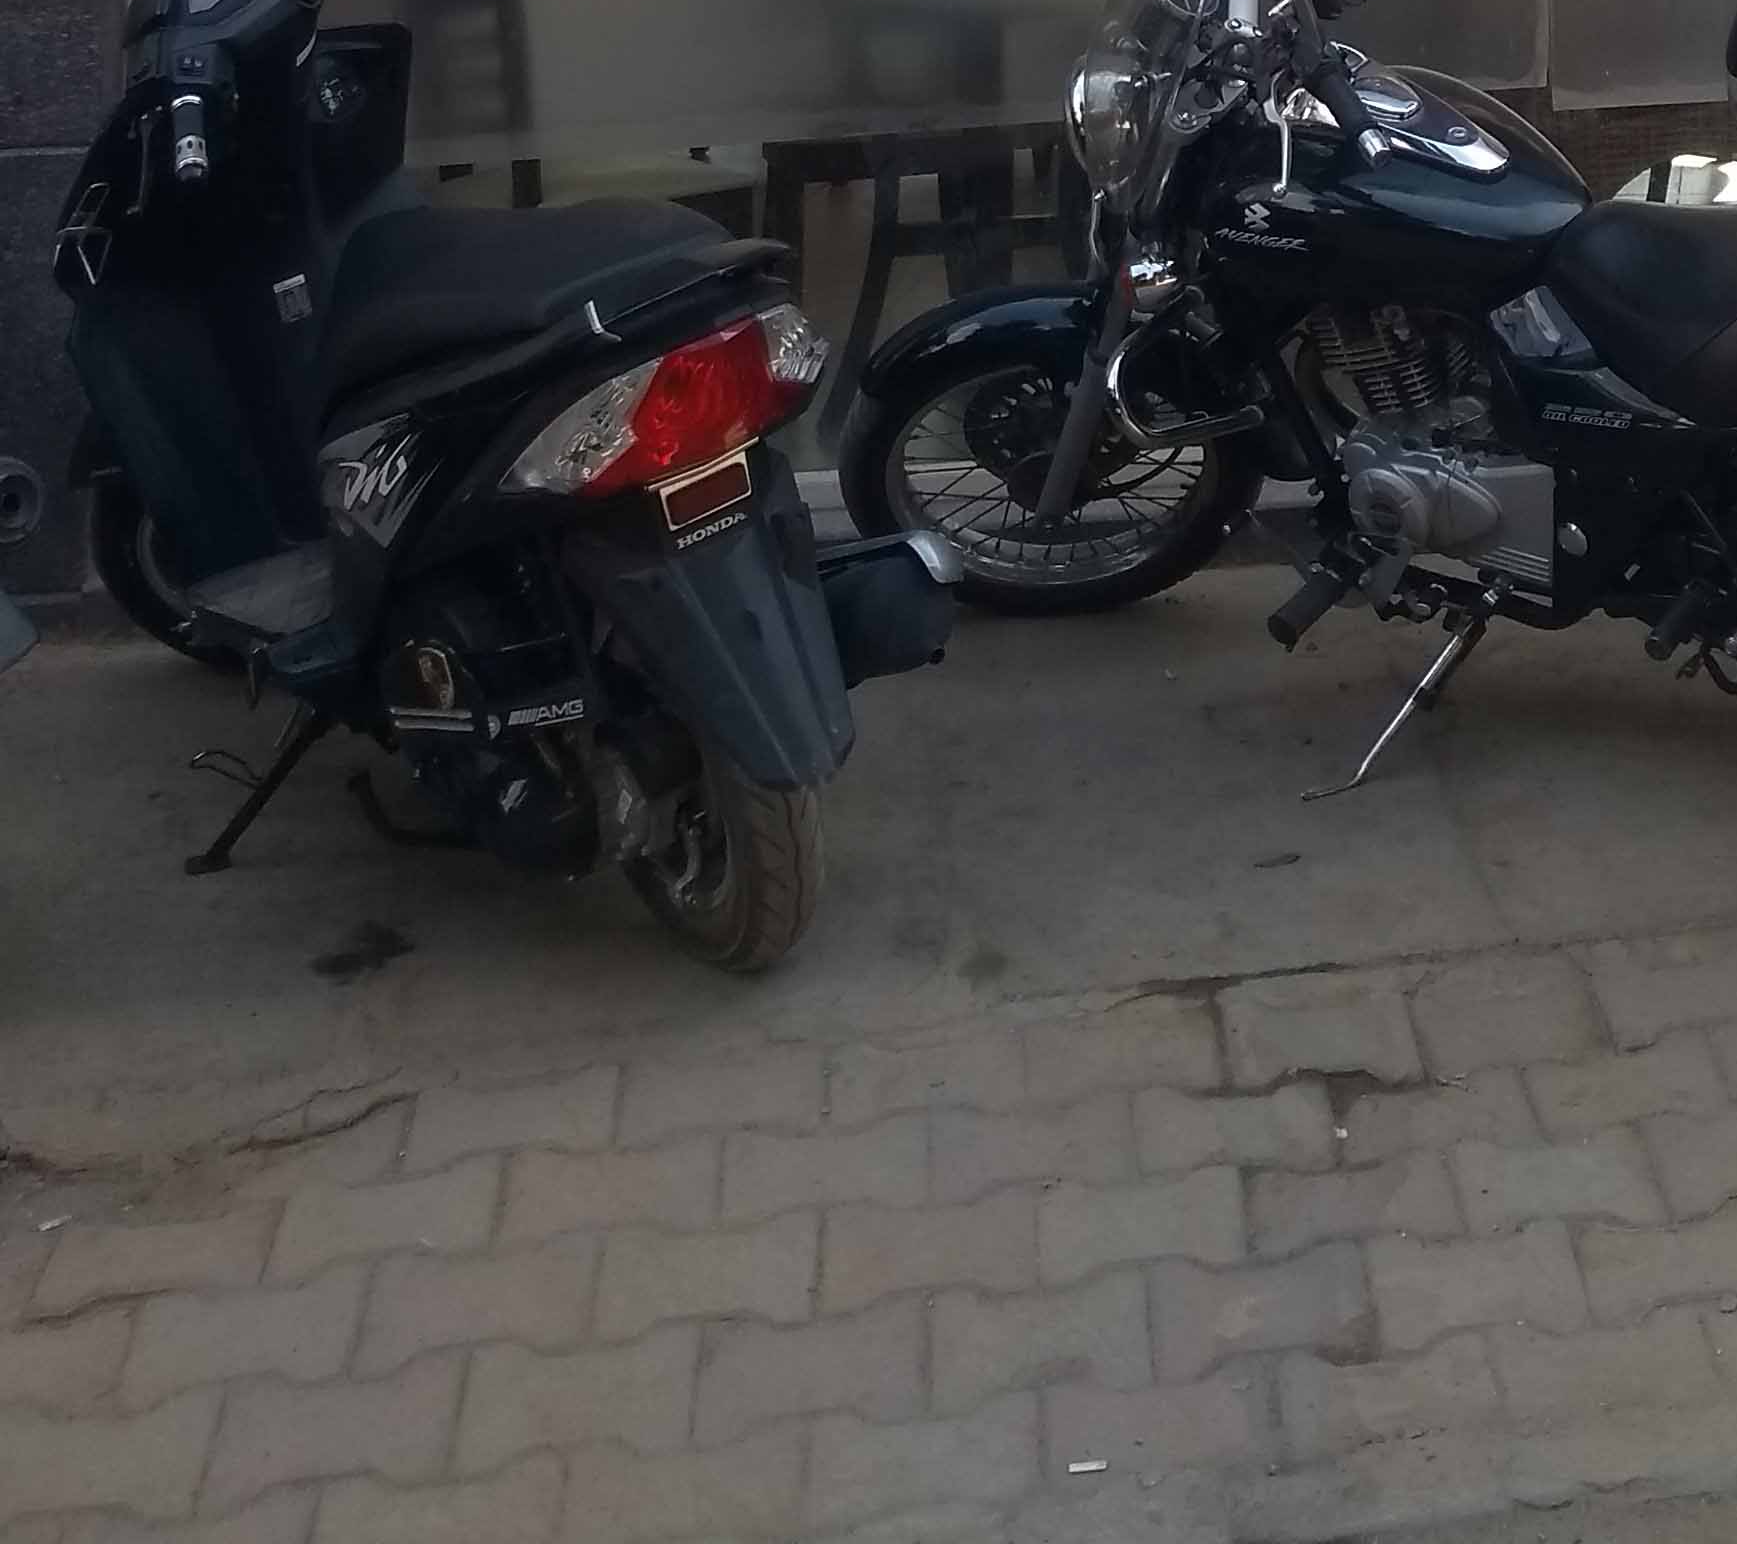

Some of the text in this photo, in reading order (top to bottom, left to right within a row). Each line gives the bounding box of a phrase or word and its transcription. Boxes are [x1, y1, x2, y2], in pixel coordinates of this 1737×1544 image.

[1215, 228, 1309, 251] AVENGER
[676, 512, 747, 550] HONDA
[536, 698, 584, 723] AMG
